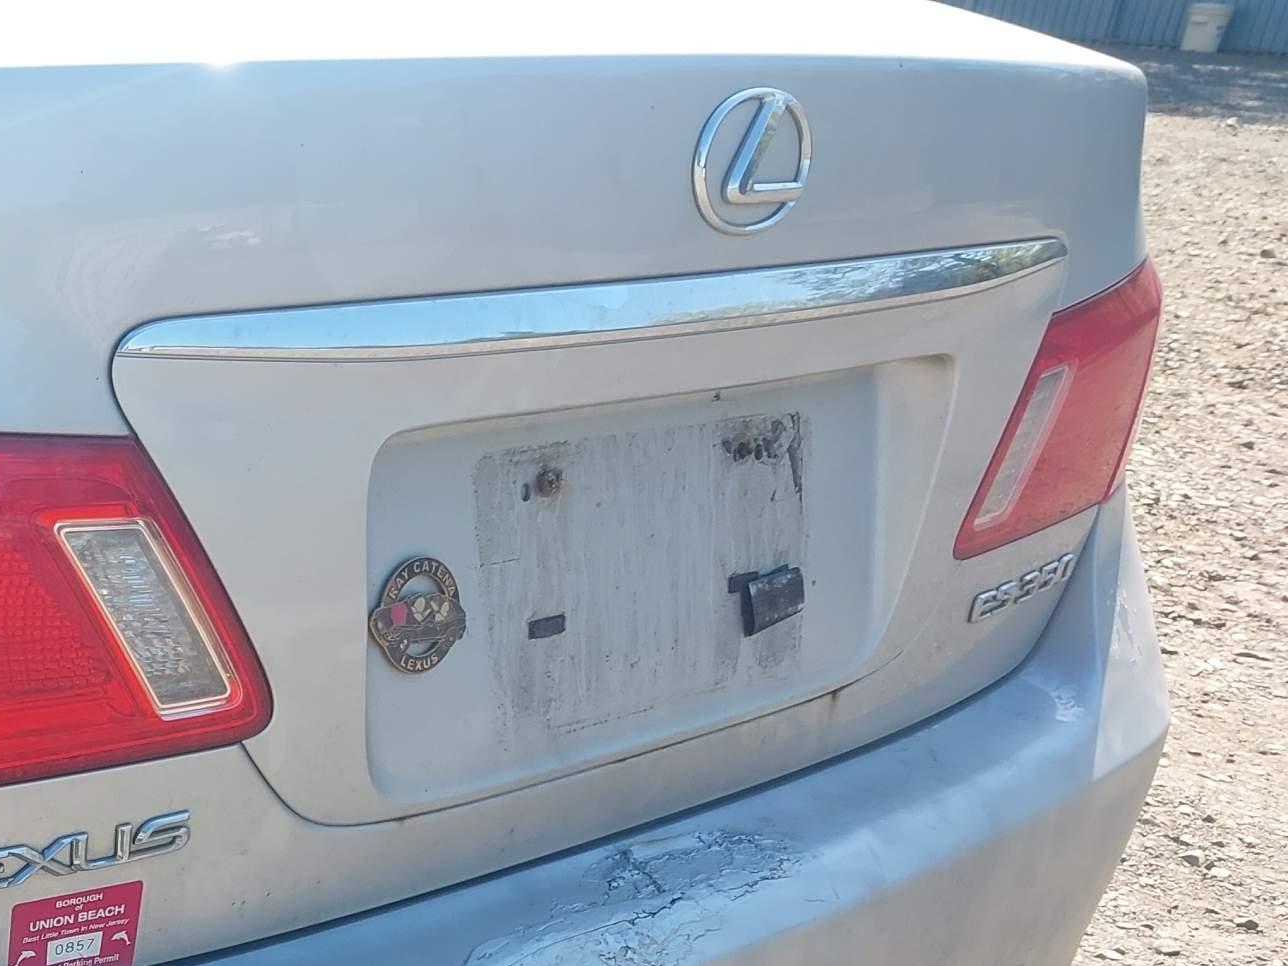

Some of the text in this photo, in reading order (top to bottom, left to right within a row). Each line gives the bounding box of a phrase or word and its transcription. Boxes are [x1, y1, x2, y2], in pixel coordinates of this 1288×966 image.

[389, 560, 456, 600] RAY CATENA
[400, 653, 439, 671] LEXUS
[55, 893, 103, 908] BOROUGH
[74, 904, 84, 912] of
[29, 904, 125, 932] UNION BEACH
[22, 935, 40, 944] Best
[41, 931, 59, 941] Little
[89, 921, 106, 931] New
[106, 918, 130, 928] Jersey
[55, 938, 95, 956] 0857
[94, 954, 120, 966] Permit
